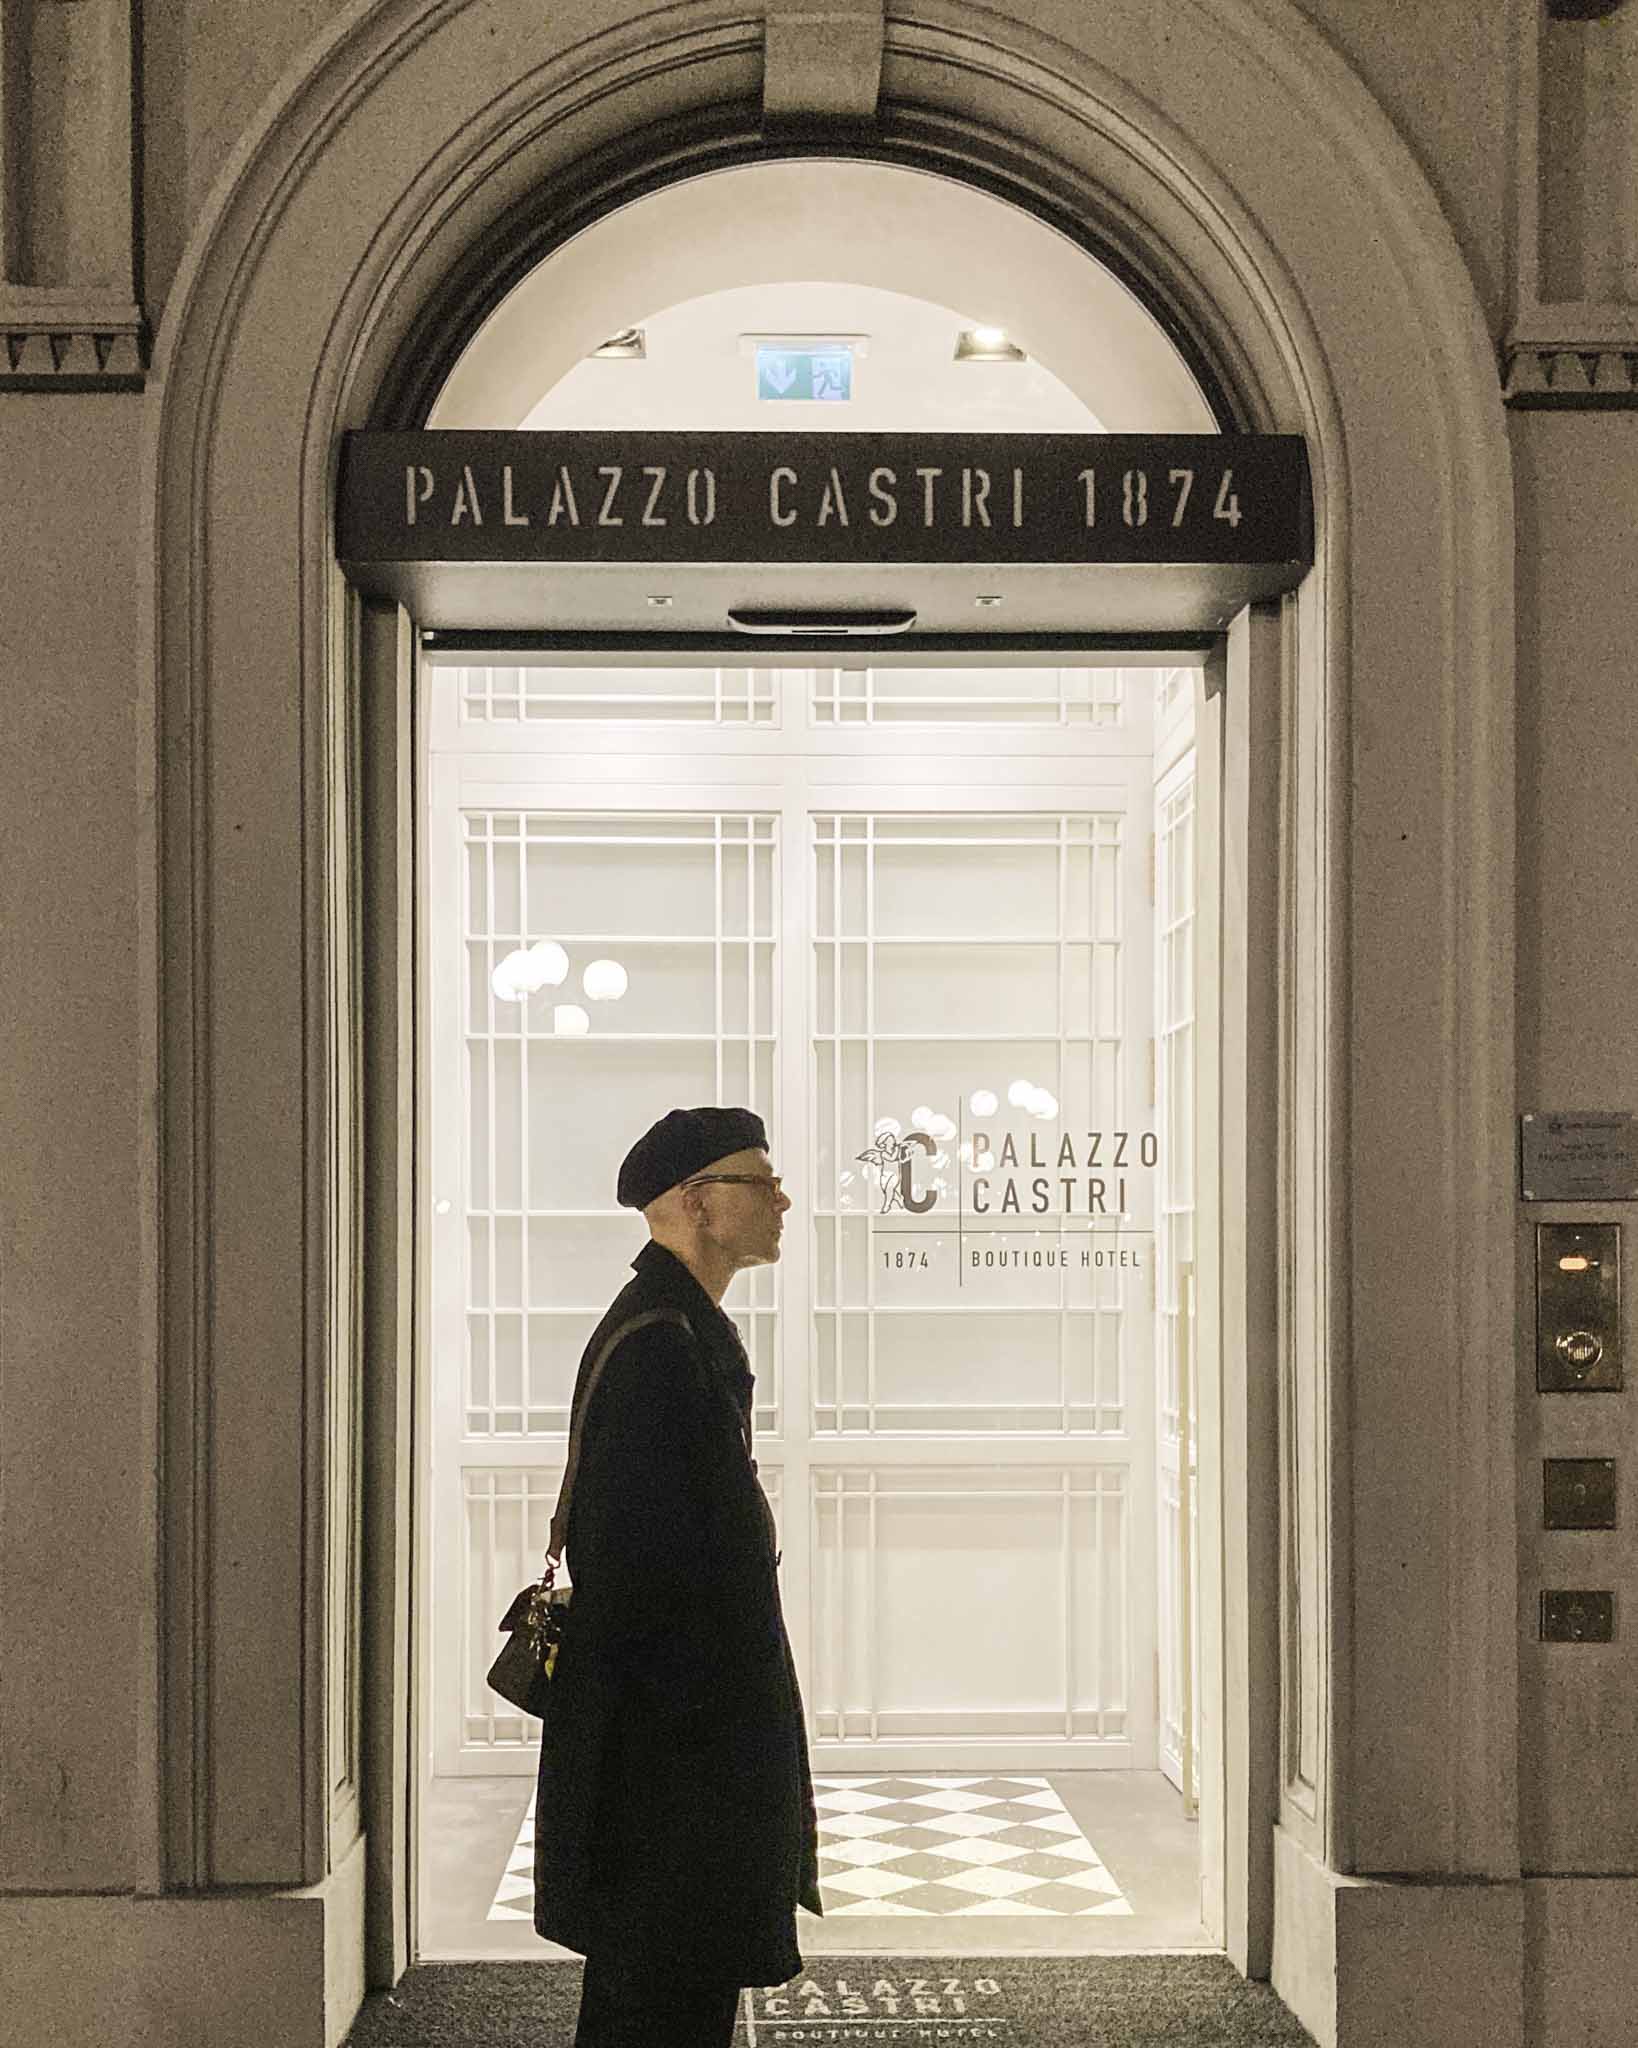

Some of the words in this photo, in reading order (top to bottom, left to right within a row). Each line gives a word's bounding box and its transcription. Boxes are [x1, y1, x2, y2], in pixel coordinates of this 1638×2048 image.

[405, 465, 716, 526] PALAZZO
[769, 466, 1023, 528] CASTRI
[1077, 468, 1243, 528] 1874
[972, 1132, 1158, 1168] PALAZZO
[972, 1178, 1126, 1213] CASTRI
[884, 1251, 929, 1268] 1874
[971, 1250, 1069, 1267] BOUTIQUE
[1080, 1250, 1141, 1267] HOTEL
[764, 1996, 966, 2016] CASTRI
